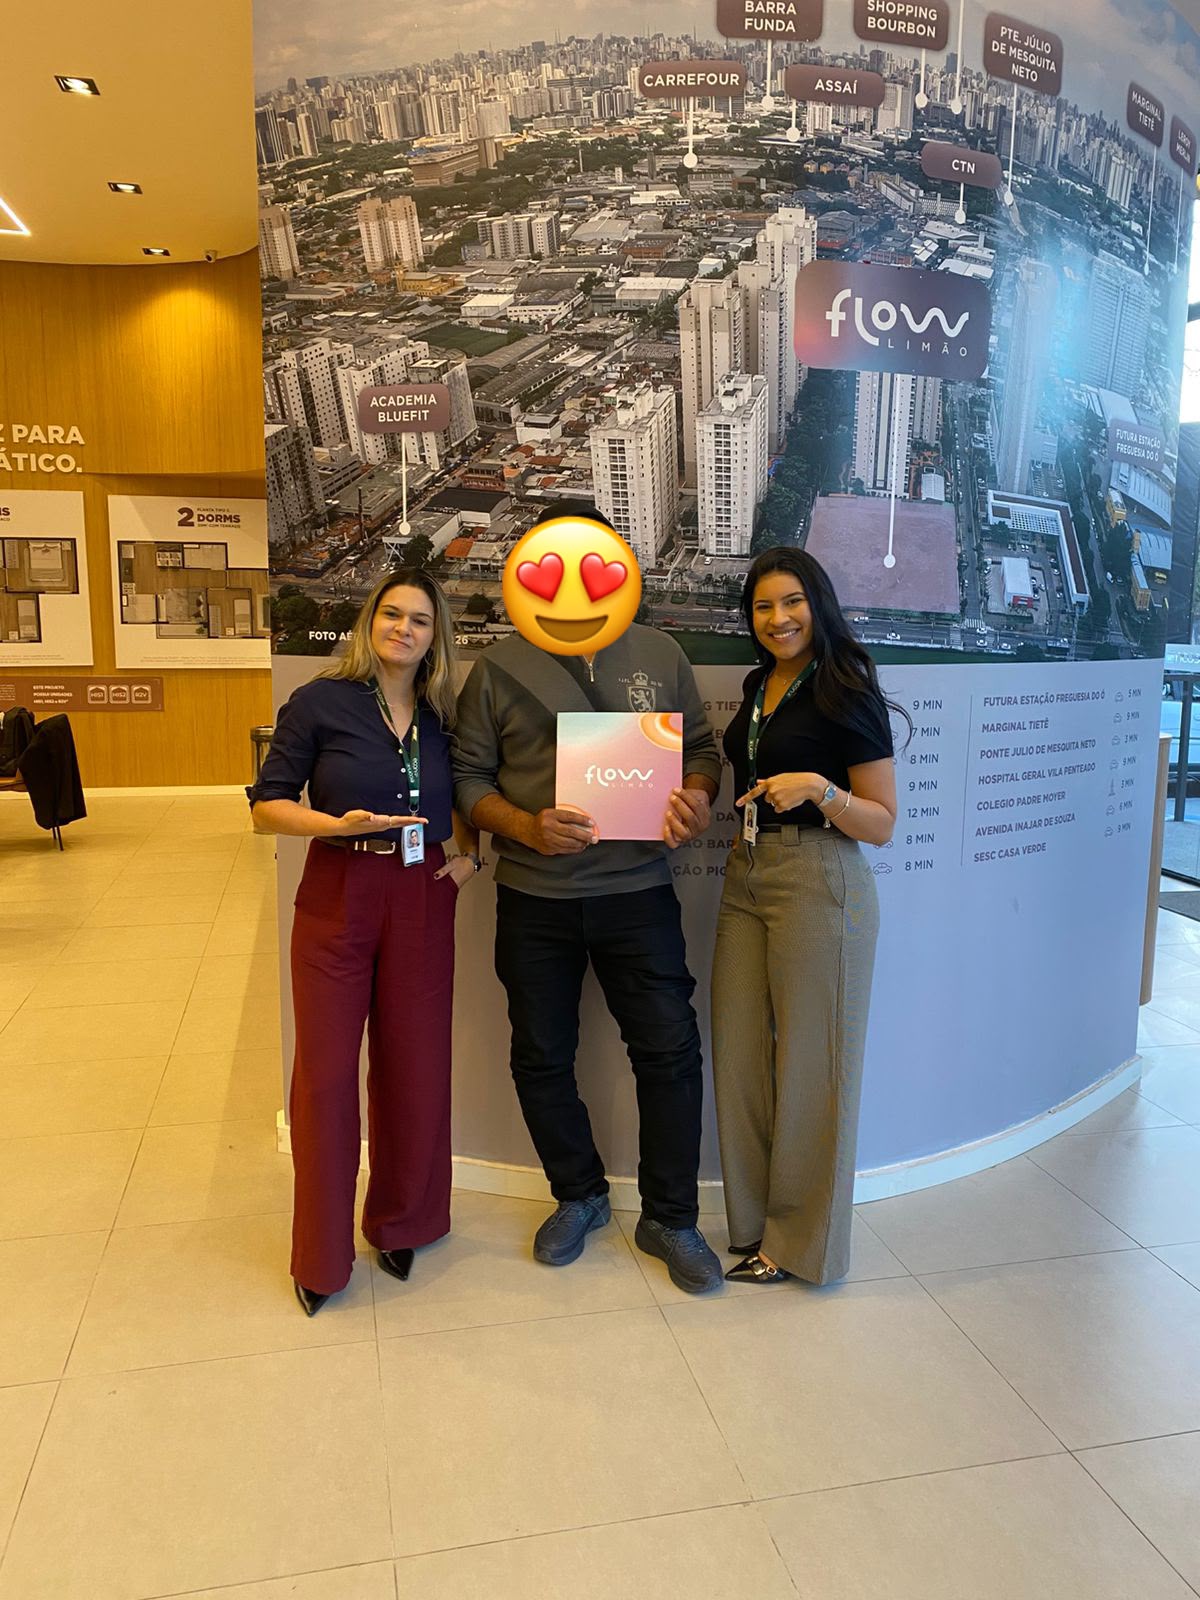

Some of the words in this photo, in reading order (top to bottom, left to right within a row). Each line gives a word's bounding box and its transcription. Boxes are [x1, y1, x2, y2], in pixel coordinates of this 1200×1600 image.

[745, 0, 797, 14] BARRA
[867, 0, 938, 20] SHOPPING
[744, 18, 796, 32] FUNDA
[867, 16, 936, 38] BOURBON
[1000, 26, 1022, 44] PTE.
[1024, 34, 1052, 54] JÚLIO
[992, 40, 1006, 54] DE
[1009, 46, 1056, 72] MESQUITA
[644, 73, 740, 87] CARREFOUR
[1012, 63, 1038, 82] NETO
[814, 78, 858, 94] ASSAÍ
[1132, 90, 1162, 122] MARGINAL
[952, 159, 976, 174] CTN
[888, 338, 968, 357] LIMÃO
[370, 394, 437, 408] ACADEMIA
[378, 410, 430, 422] BLUEFIT
[12, 424, 86, 444] PARA
[1116, 429, 1138, 444] FUTURA
[1116, 442, 1146, 458] FREGUESIA
[178, 507, 194, 526] 2
[197, 514, 240, 523] DORMS
[308, 631, 336, 640] FOTO
[913, 700, 920, 710] 9
[923, 700, 942, 710] MIN
[984, 696, 1018, 706] FUTURA
[1020, 692, 1054, 706] ESTAÇÃO
[1056, 692, 1090, 702] FREGUESIA
[1092, 691, 1100, 700] DO
[912, 728, 918, 737] 7
[921, 727, 940, 737] MIN
[982, 722, 1026, 733] MARGINAL
[980, 748, 1010, 760] PONTE
[1011, 746, 1034, 757] JULIO
[1036, 744, 1046, 754] DE
[1046, 742, 1080, 754] MESQUITA
[1080, 739, 1096, 750] NETO
[910, 754, 916, 764] 8
[920, 754, 939, 764] MIN
[978, 773, 1020, 785] HOSPITAL
[1022, 770, 1046, 780] GERAL
[1048, 766, 1063, 777] VILA
[1064, 762, 1096, 776] PENTEADO
[908, 782, 916, 791] 9
[918, 780, 938, 791] MIN
[976, 798, 1014, 811] COLEGIO
[1016, 794, 1042, 806] PADRE
[908, 808, 918, 818] 12
[921, 806, 940, 817] MIN
[976, 824, 1013, 837] AVENIDA
[1015, 818, 1042, 832] INAJAR
[1044, 817, 1053, 827] DE
[1054, 813, 1076, 824] SOUZA
[906, 835, 912, 844] 8
[916, 834, 934, 844] MIN
[974, 851, 996, 862] SESC
[998, 848, 1020, 860] CASA
[1022, 842, 1046, 855] VERDE
[905, 861, 912, 871] 8
[914, 860, 934, 870] MIN
